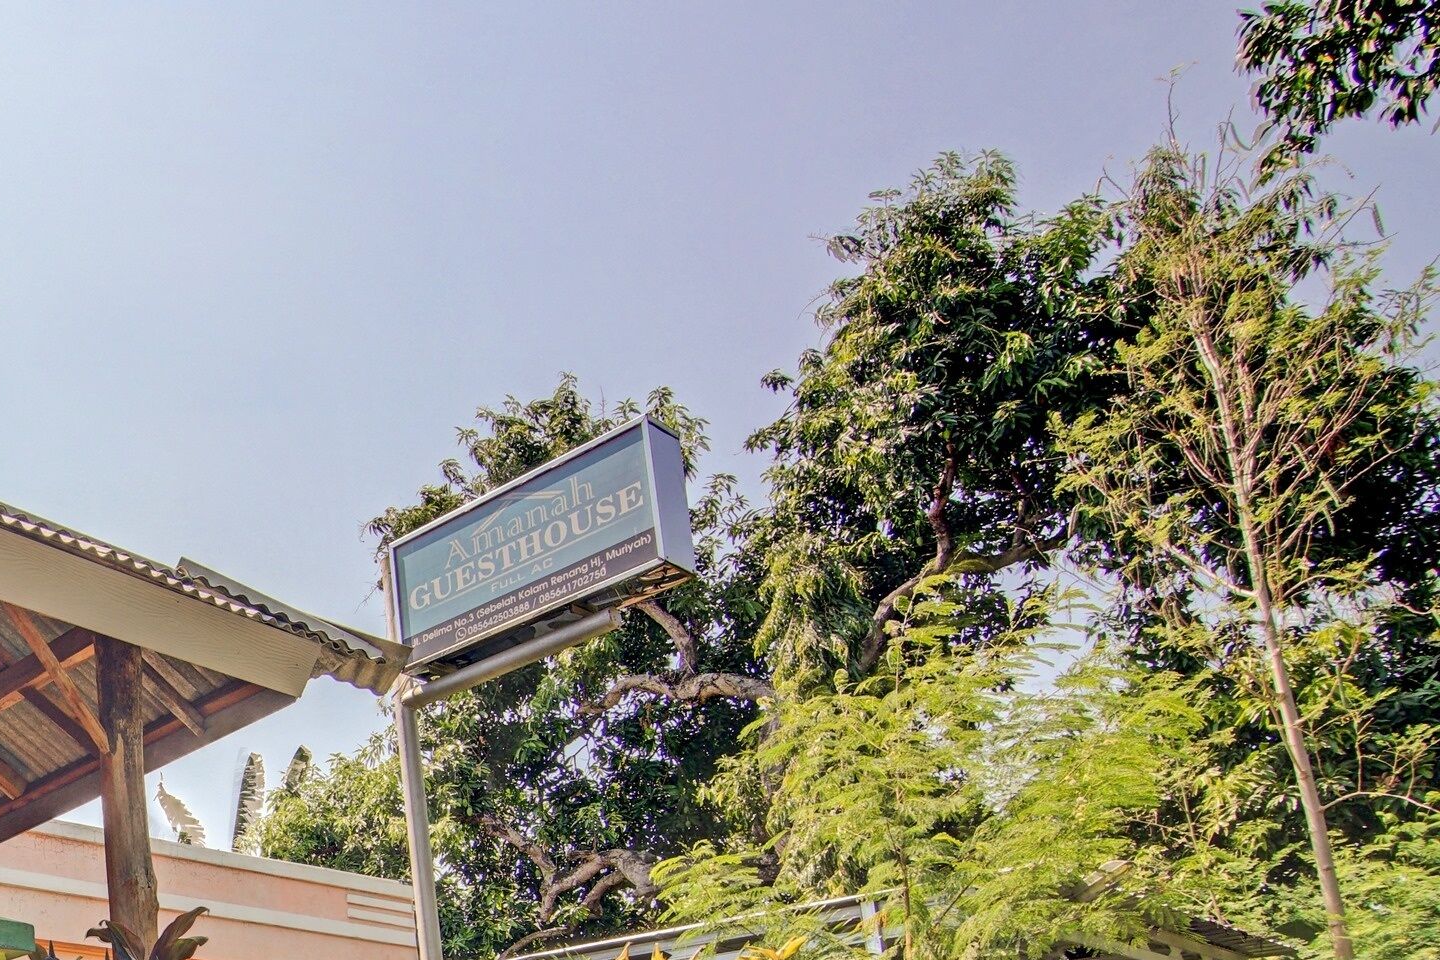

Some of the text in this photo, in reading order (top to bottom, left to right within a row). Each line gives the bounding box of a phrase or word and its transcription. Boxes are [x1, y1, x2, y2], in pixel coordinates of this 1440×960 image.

[409, 481, 644, 611] GUESTHOUSE
[444, 476, 595, 570] Amanah
[422, 624, 453, 643] Delima
[454, 613, 475, 629] No.3
[476, 595, 517, 619] (Sebelah
[518, 580, 549, 600] Kolam
[550, 563, 589, 586] Renang
[605, 534, 652, 561] Muriyah)
[490, 557, 553, 593] FULL AC
